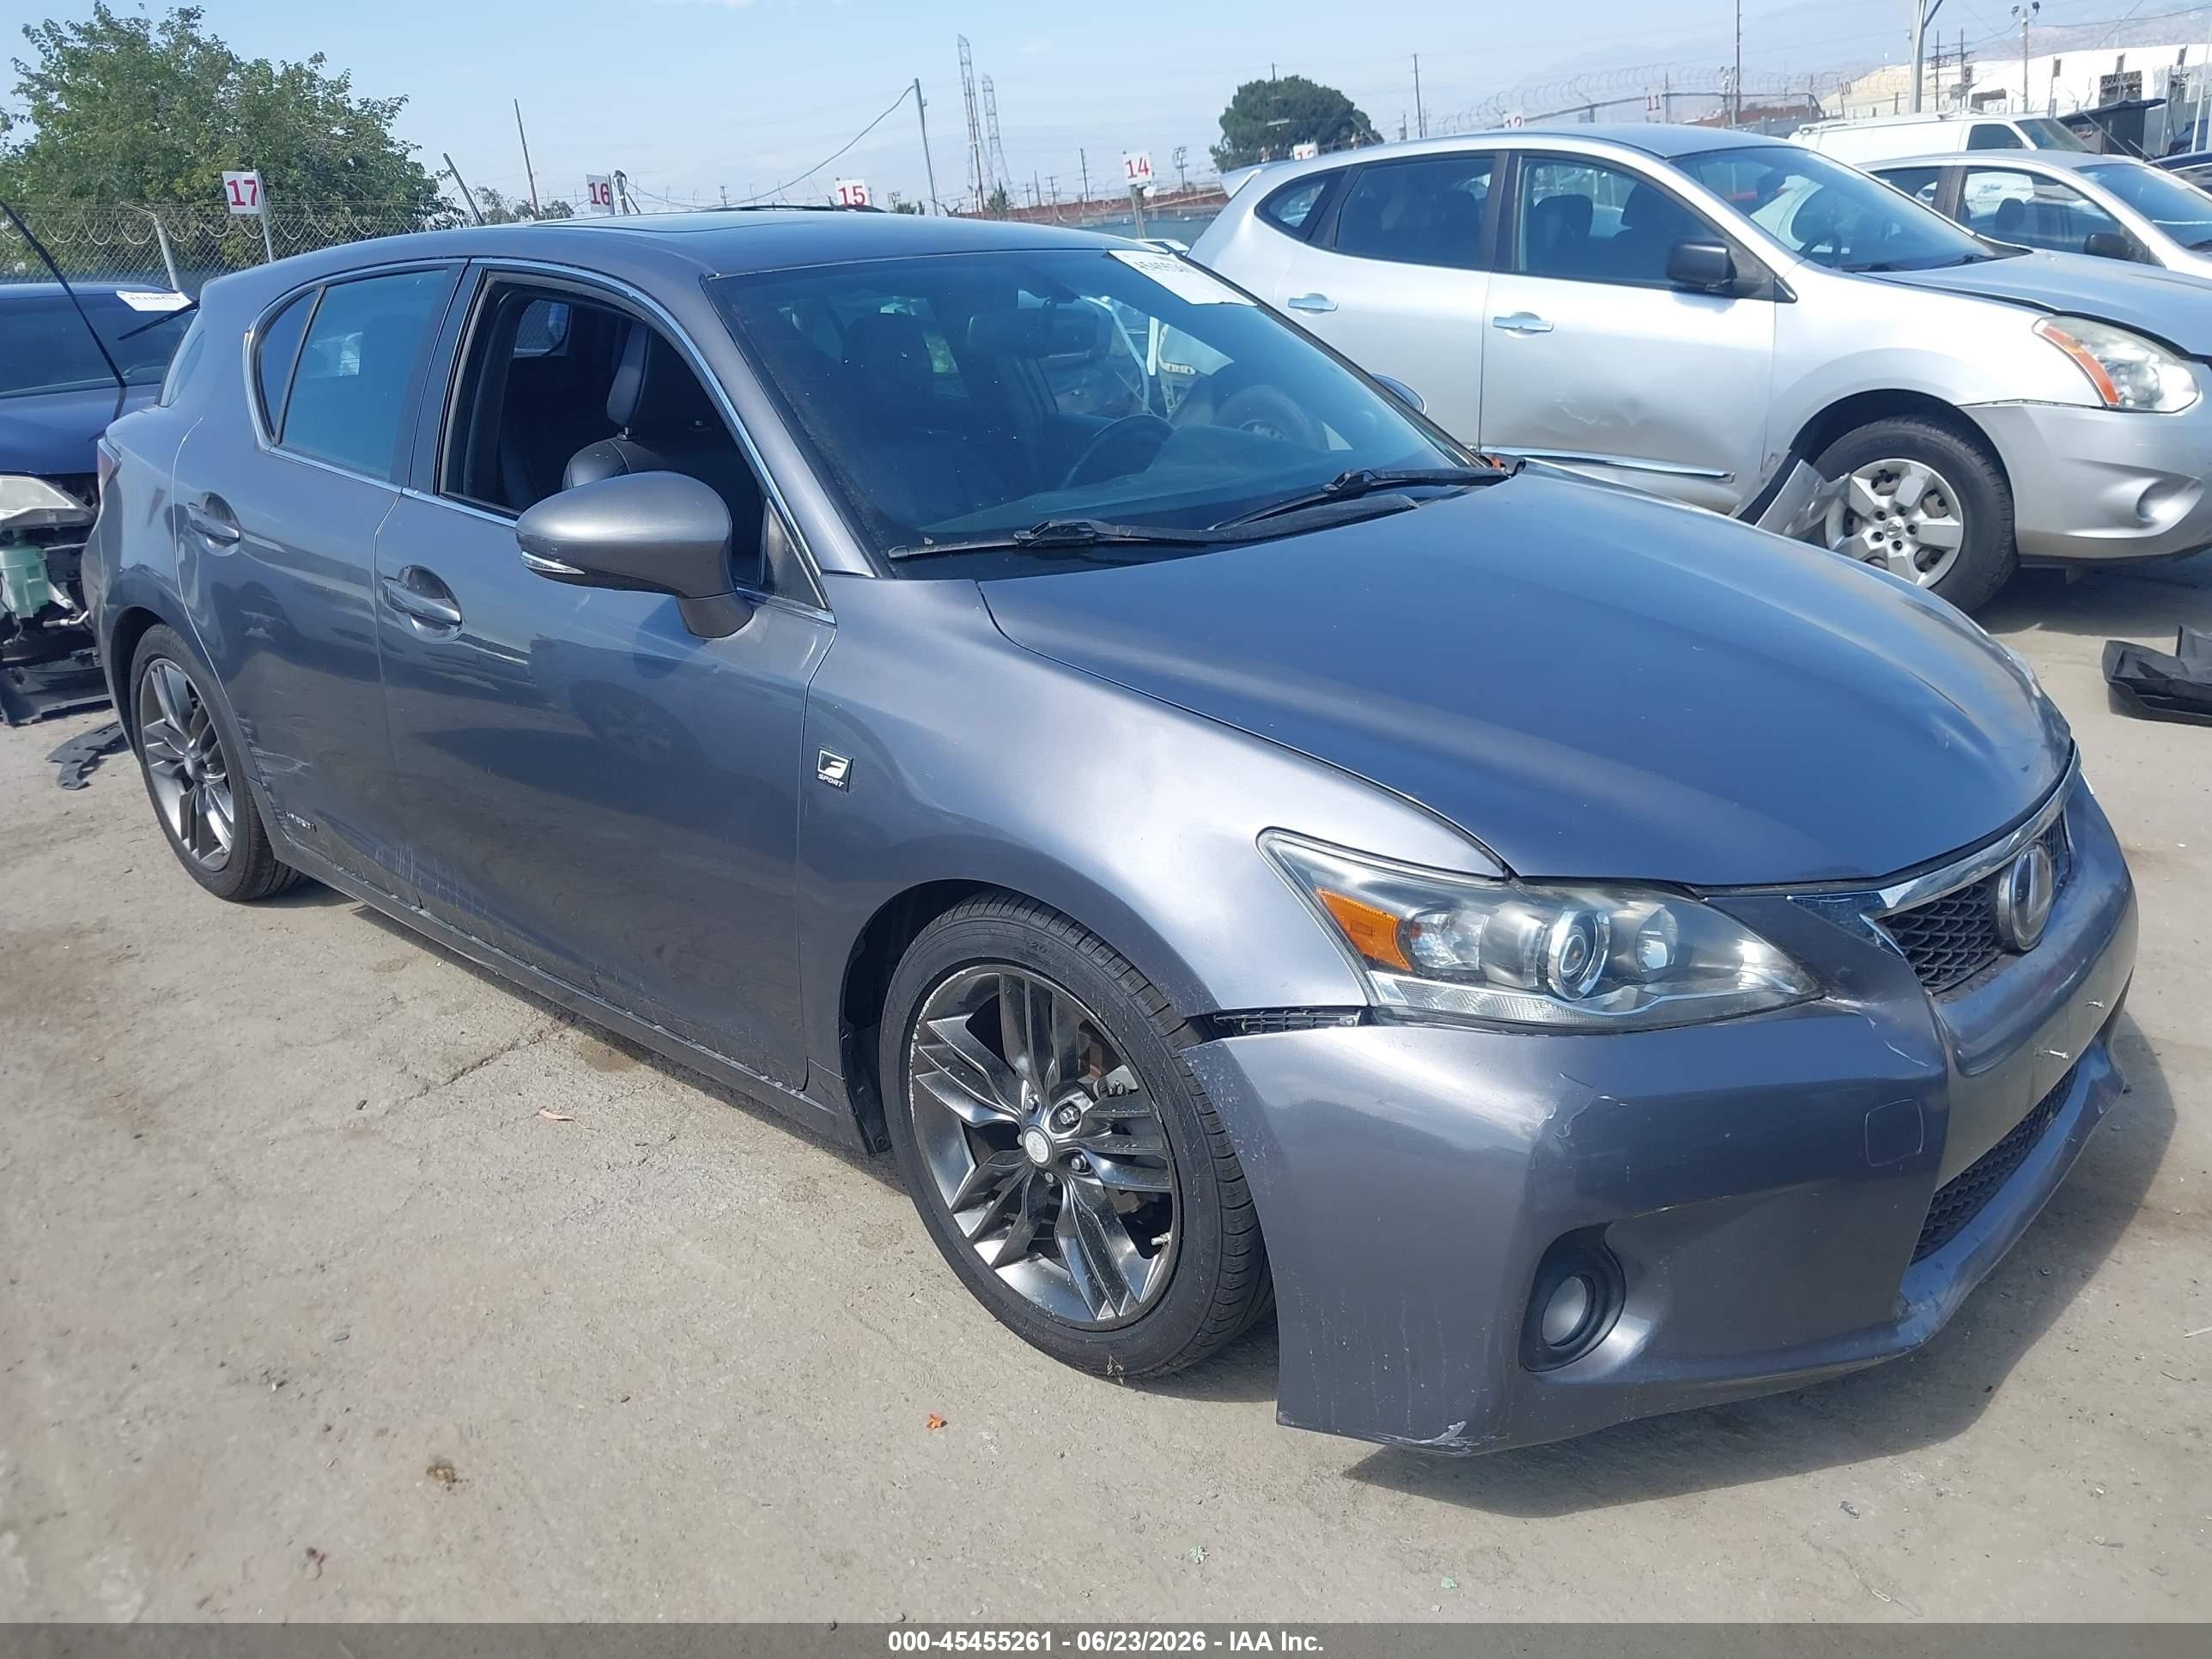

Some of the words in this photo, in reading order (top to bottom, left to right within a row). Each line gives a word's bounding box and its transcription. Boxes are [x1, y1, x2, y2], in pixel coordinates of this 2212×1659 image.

[1964, 68, 1971, 83] 9
[1840, 82, 1851, 95] 10
[1647, 94, 1661, 111] 11
[1125, 157, 1149, 179] 14
[227, 179, 258, 206] 17
[588, 182, 611, 206] 16
[838, 185, 866, 206] 15
[817, 774, 845, 787] SPORT
